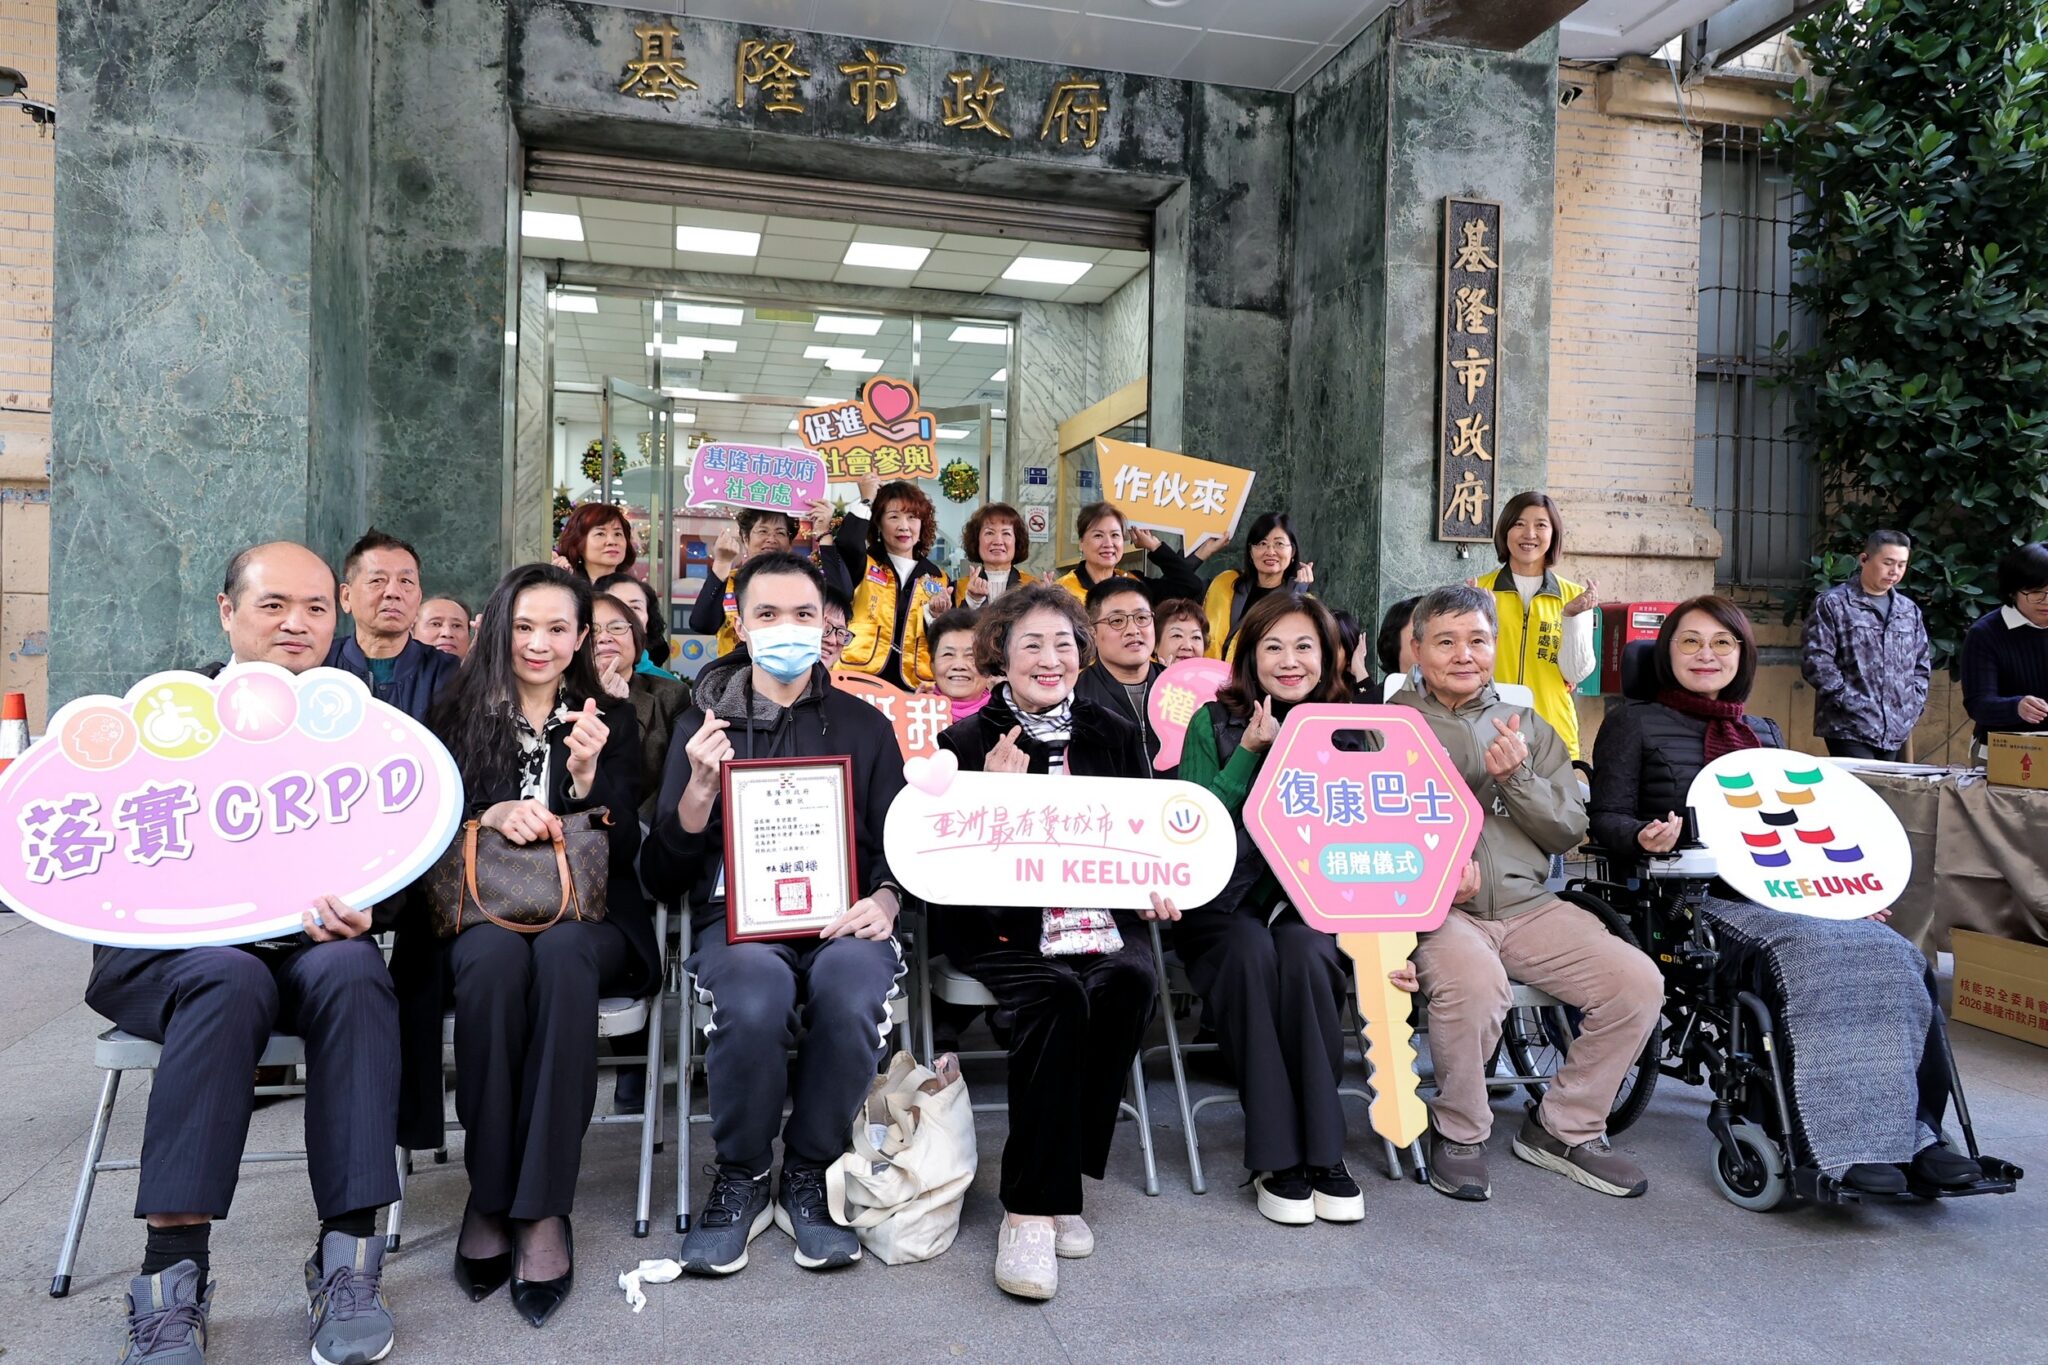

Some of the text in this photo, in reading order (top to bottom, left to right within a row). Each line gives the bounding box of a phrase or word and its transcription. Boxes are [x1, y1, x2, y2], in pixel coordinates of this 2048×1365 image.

[619, 22, 1108, 149] 基隆市政府
[1444, 218, 1498, 526] 基隆市政府
[804, 406, 868, 445] 促進
[704, 447, 818, 482] 基隆市政府
[820, 445, 931, 477] 社會參與
[725, 477, 792, 506] 社會處
[1114, 464, 1228, 515] 作伙來
[1537, 621, 1552, 661] 副處長
[855, 693, 950, 750] 我
[1279, 770, 1453, 824] 復康巴士
[1016, 858, 1191, 886] IN KEELUNG
[1326, 850, 1419, 876] 捐贈儀式
[1764, 873, 1884, 899] KEELUNG
